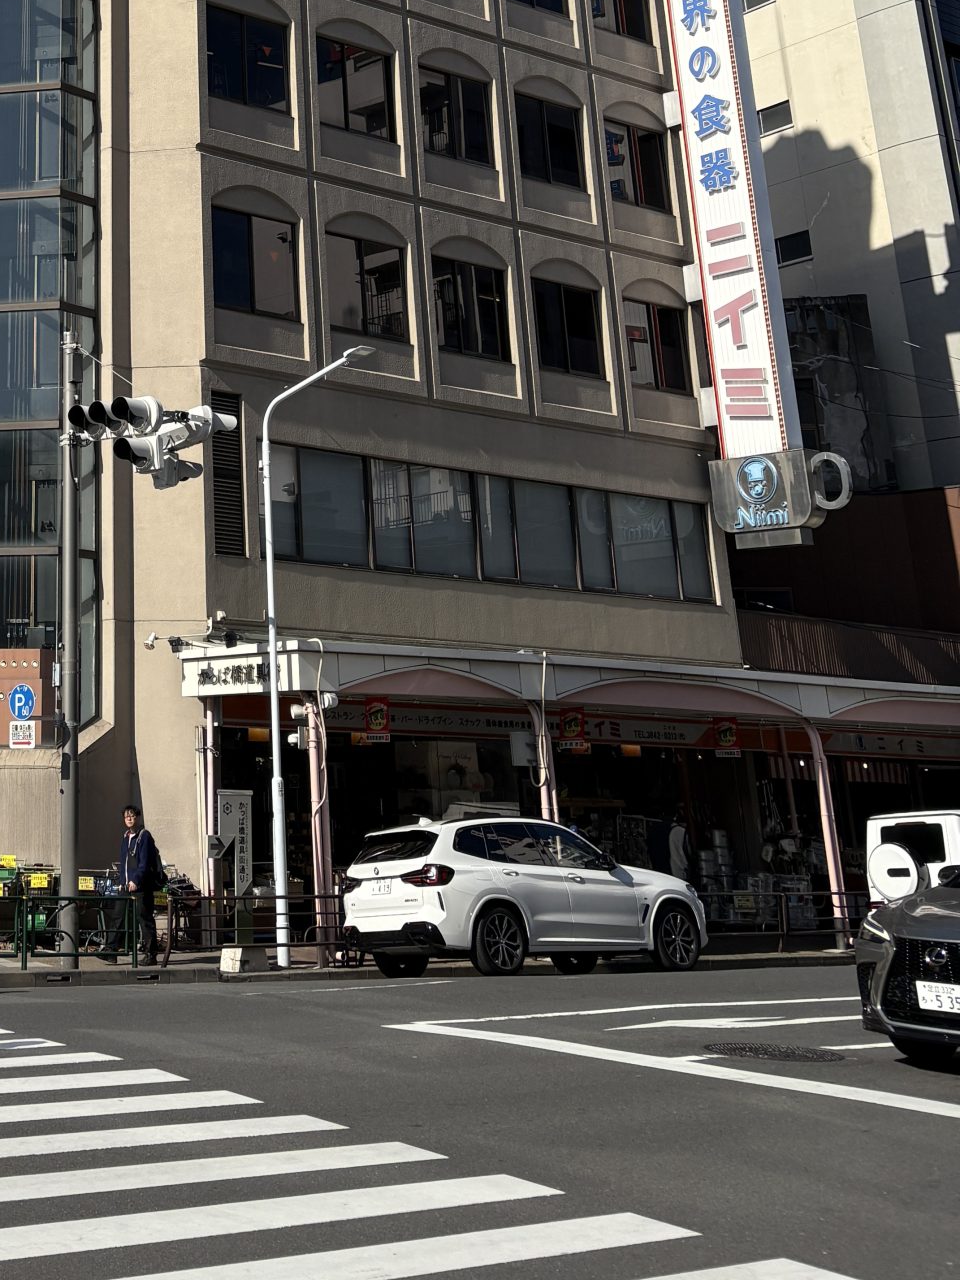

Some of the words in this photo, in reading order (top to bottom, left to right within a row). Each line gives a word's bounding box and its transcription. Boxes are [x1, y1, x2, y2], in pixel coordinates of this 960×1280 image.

[706, 221, 773, 419] ニイミ
[734, 502, 789, 529] Niimi
[15, 693, 25, 716] P
